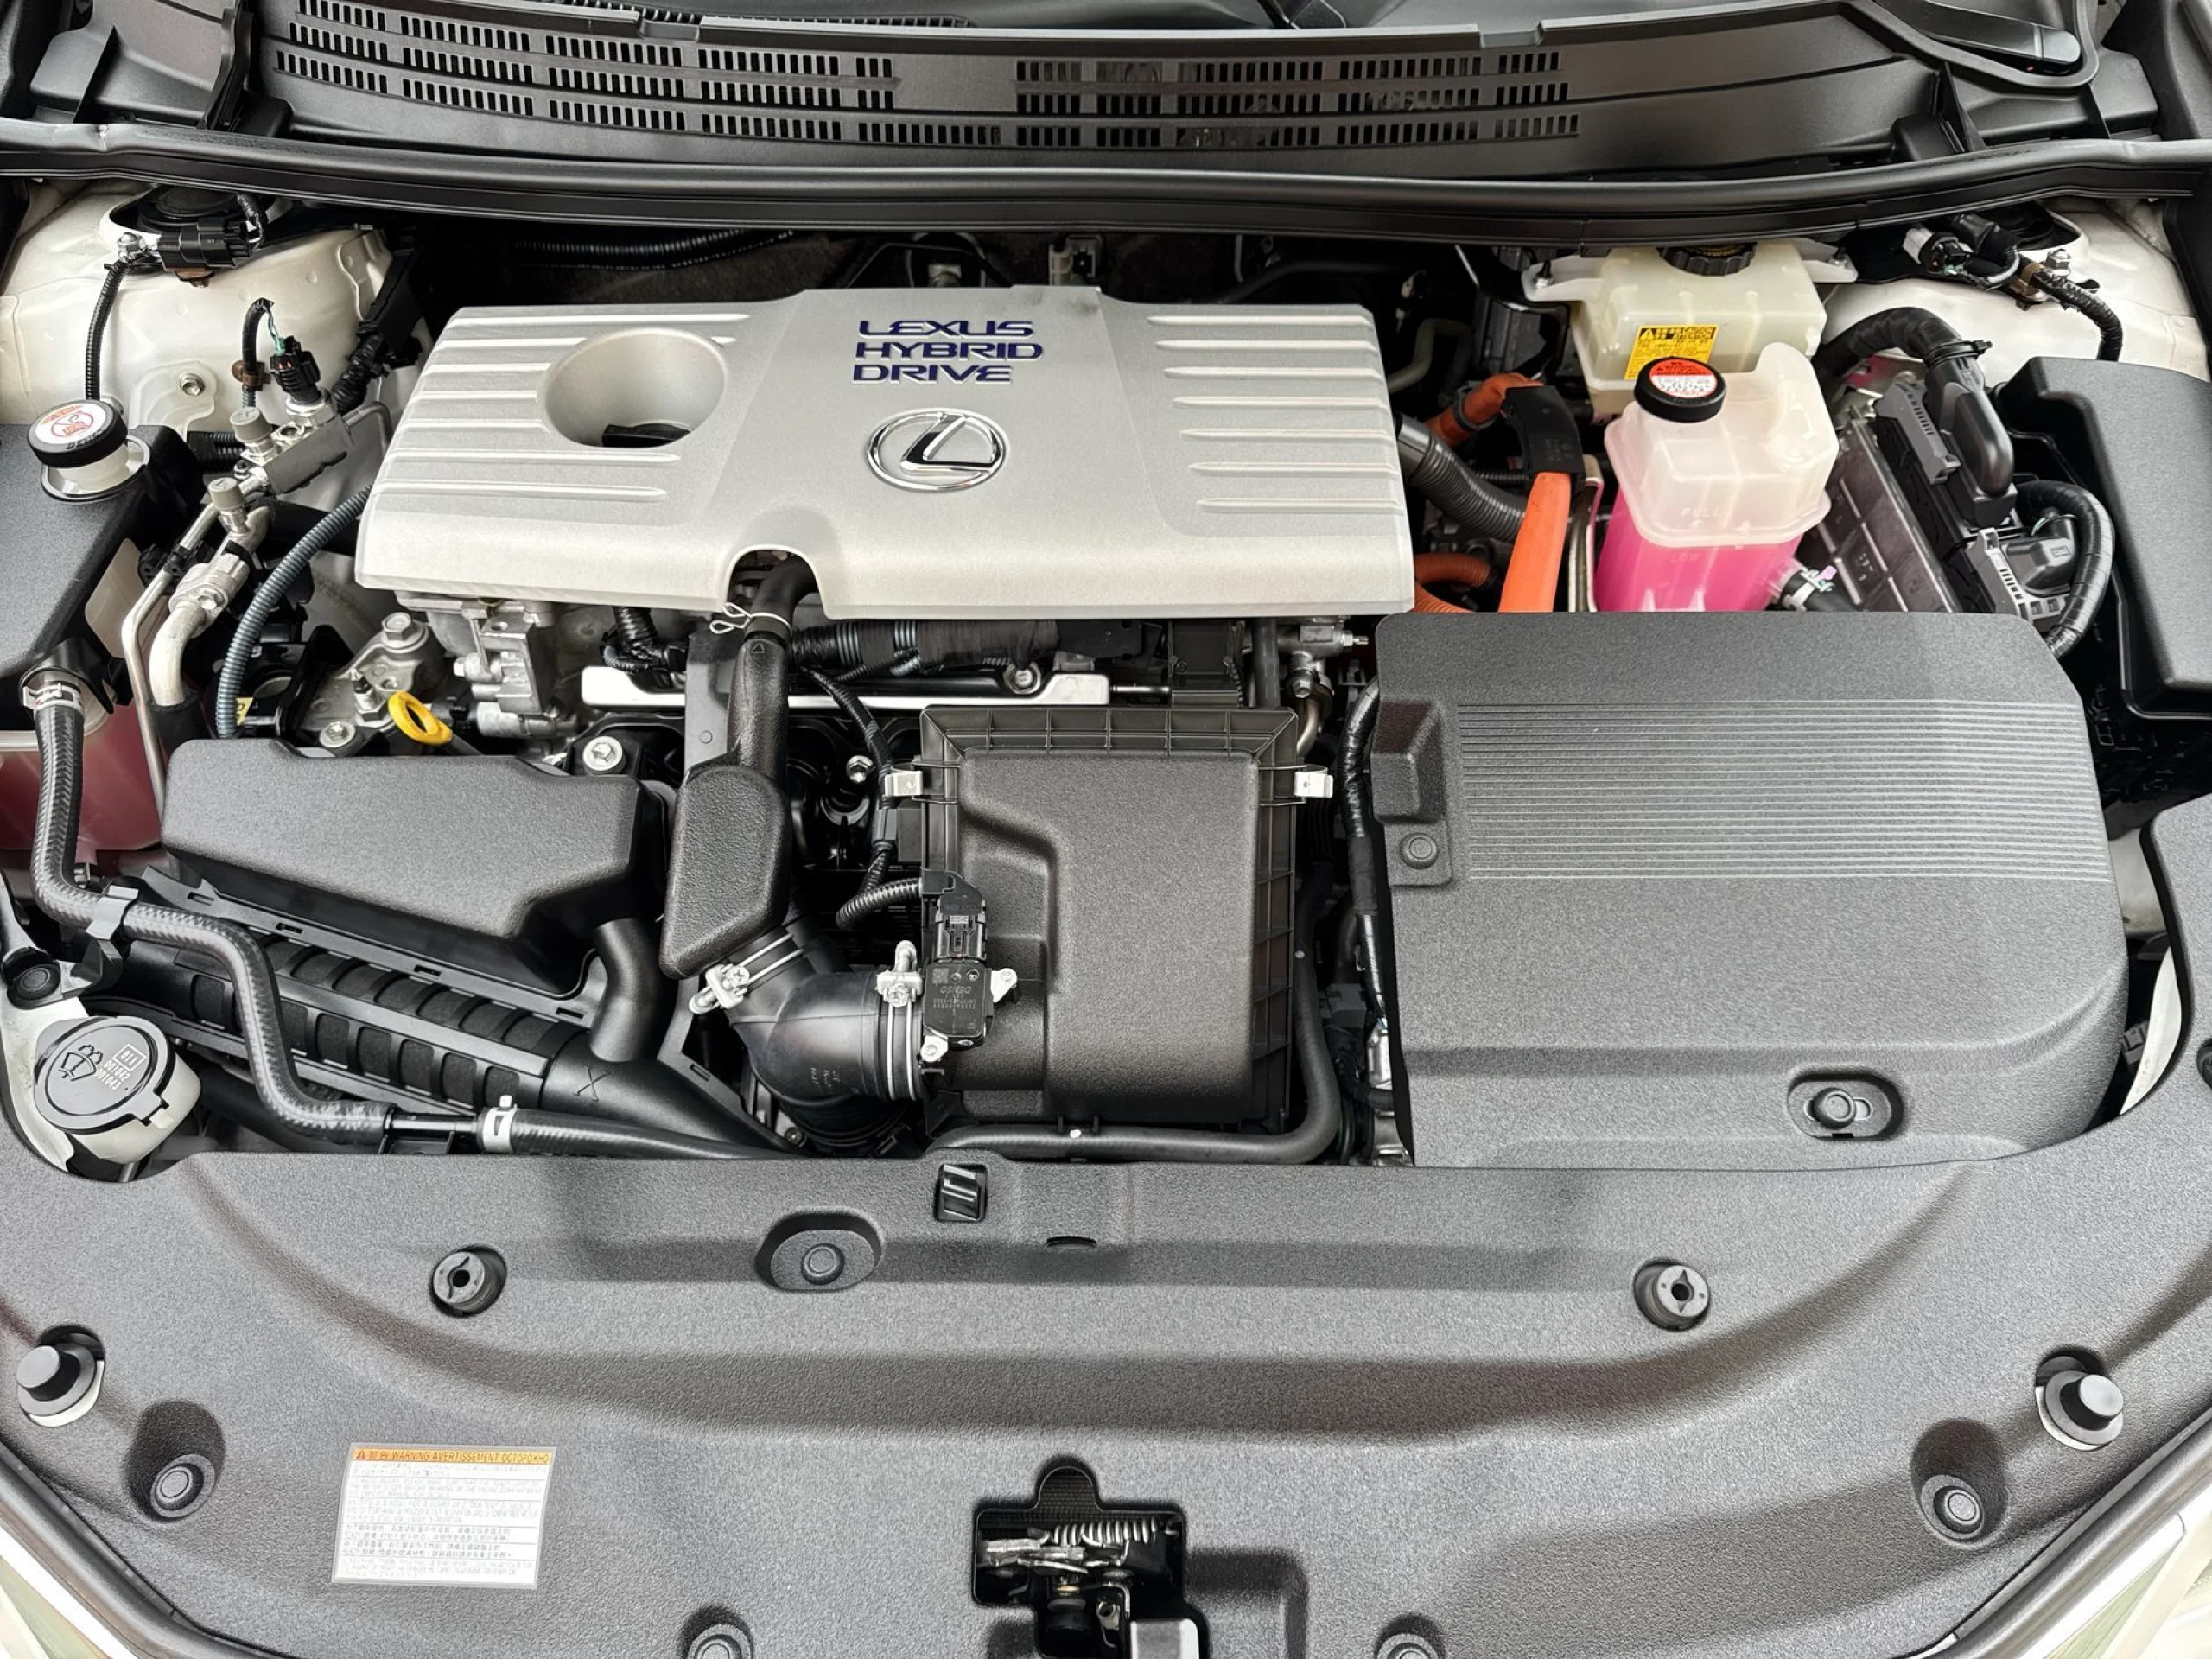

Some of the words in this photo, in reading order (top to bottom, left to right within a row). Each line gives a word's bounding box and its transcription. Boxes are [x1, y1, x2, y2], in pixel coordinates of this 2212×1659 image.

[859, 320, 1034, 338] LEXUS
[855, 341, 1044, 360] HYBRID
[852, 364, 1013, 383] DRIVE
[392, 1451, 430, 1460] WARNING
[432, 1452, 499, 1462] AVERTISSEMENT
